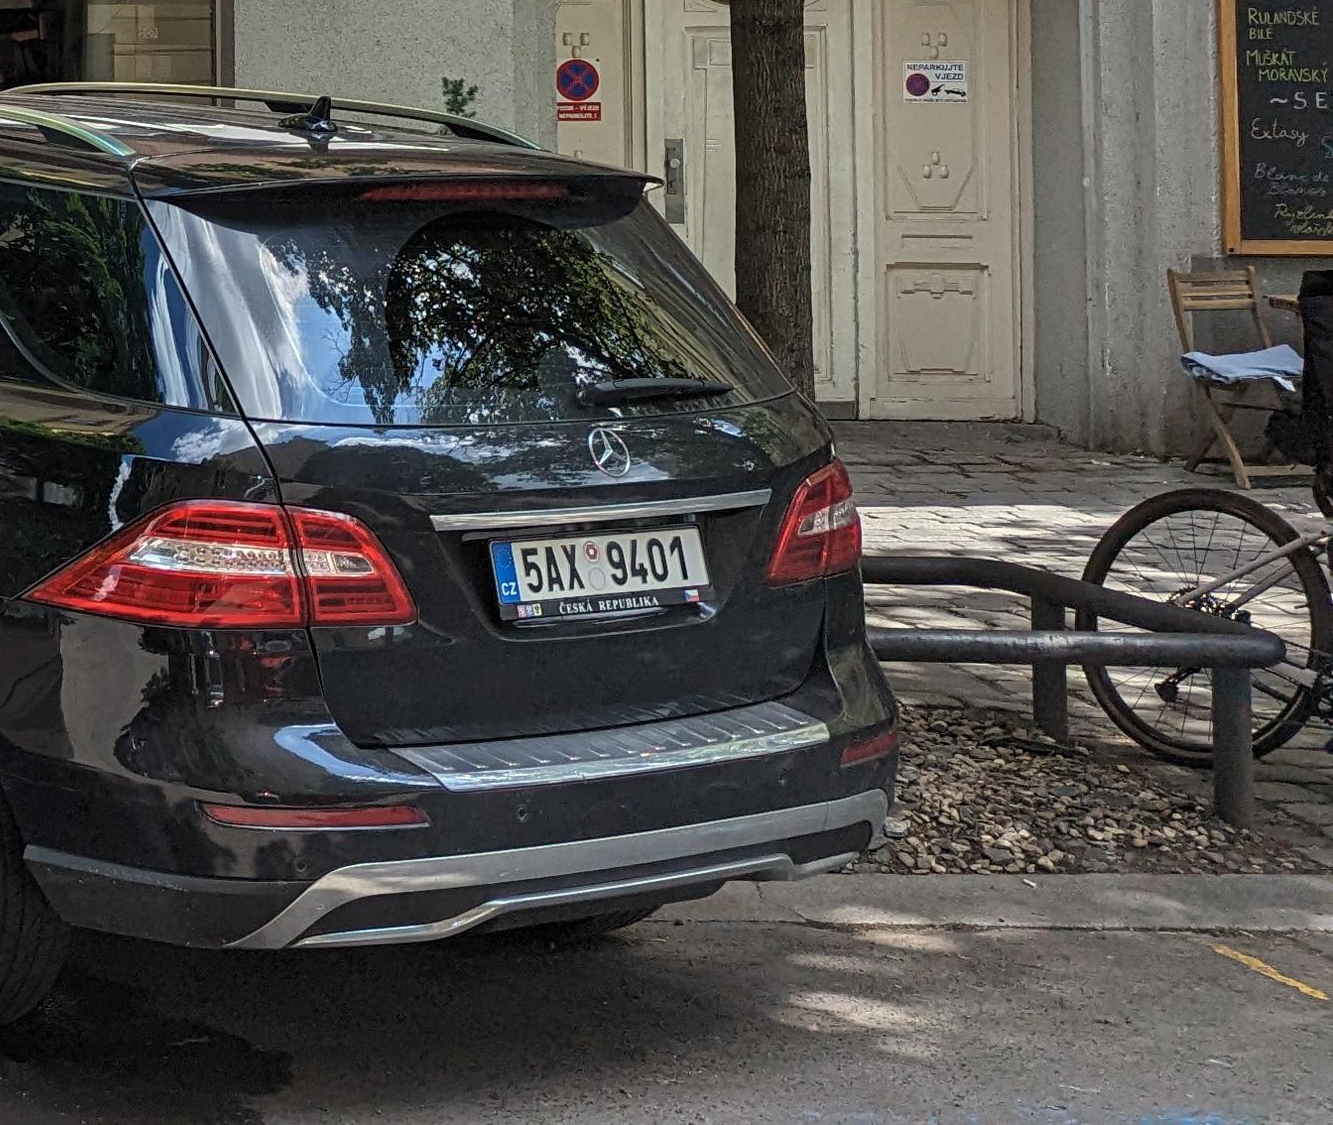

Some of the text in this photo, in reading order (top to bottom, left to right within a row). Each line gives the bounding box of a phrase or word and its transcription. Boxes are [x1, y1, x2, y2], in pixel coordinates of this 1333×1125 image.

[520, 535, 690, 594] 5AX 9401
[501, 581, 518, 596] CZ
[559, 595, 660, 615] ČESKÁ REPUBLIKA
